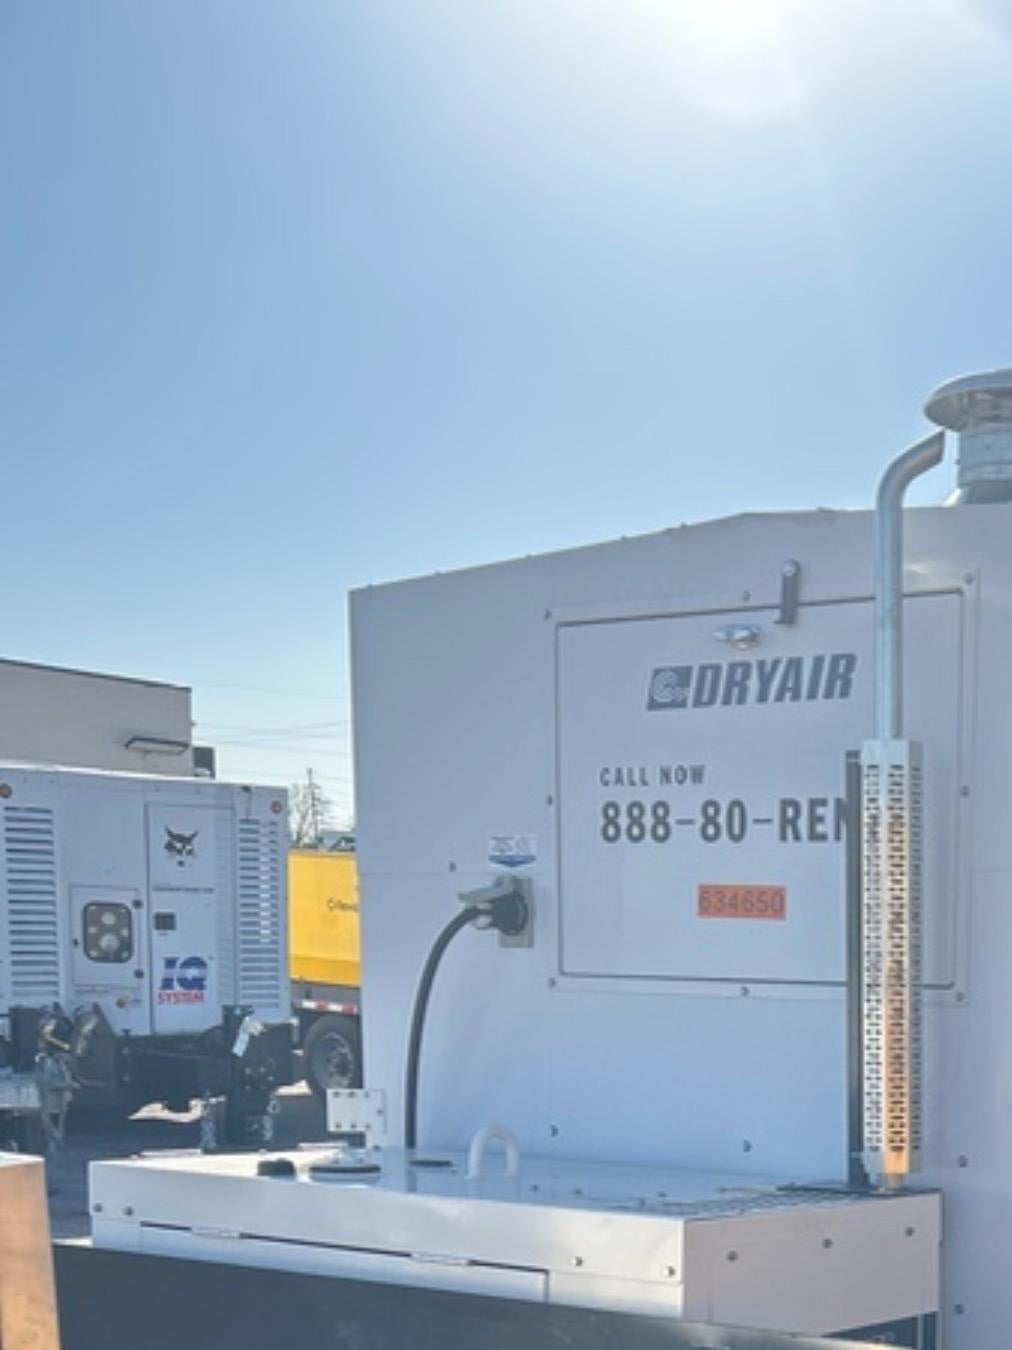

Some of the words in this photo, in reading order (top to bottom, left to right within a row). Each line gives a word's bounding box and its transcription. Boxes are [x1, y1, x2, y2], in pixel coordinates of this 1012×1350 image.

[691, 653, 858, 709] DRYAIR
[599, 766, 650, 787] CALL
[658, 764, 706, 786] NOW
[698, 888, 786, 916] 634650
